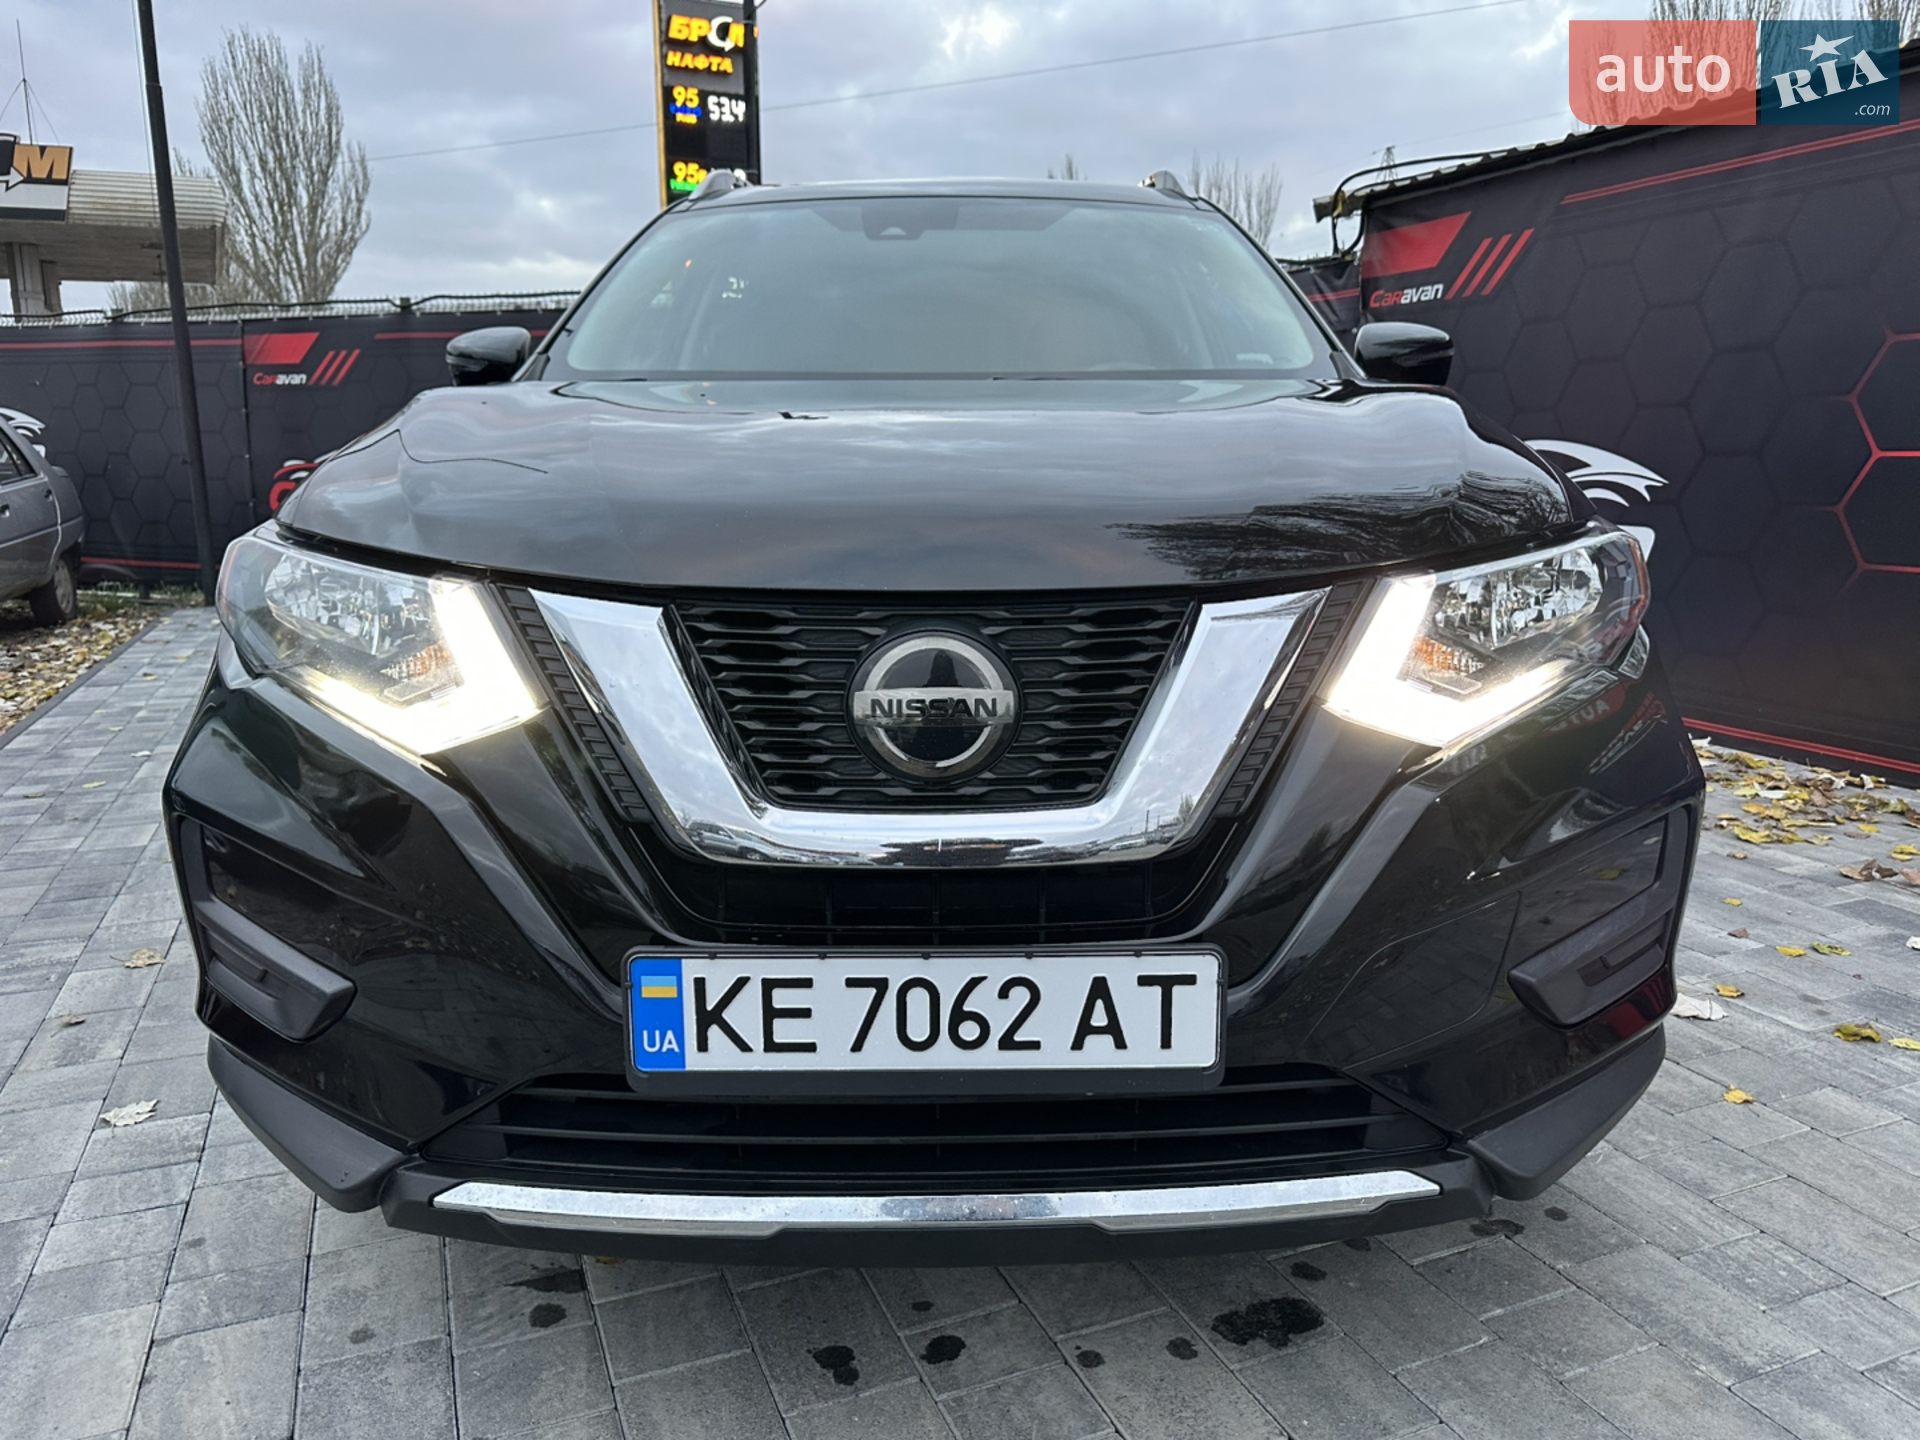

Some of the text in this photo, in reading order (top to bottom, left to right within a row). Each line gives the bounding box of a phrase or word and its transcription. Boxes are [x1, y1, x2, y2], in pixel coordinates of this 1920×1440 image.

[666, 50, 734, 75] НАФТА
[672, 85, 699, 108] 95
[870, 697, 998, 719] NISSAN
[693, 974, 1198, 1053] KE 7062 AT
[643, 1029, 680, 1053] UA
